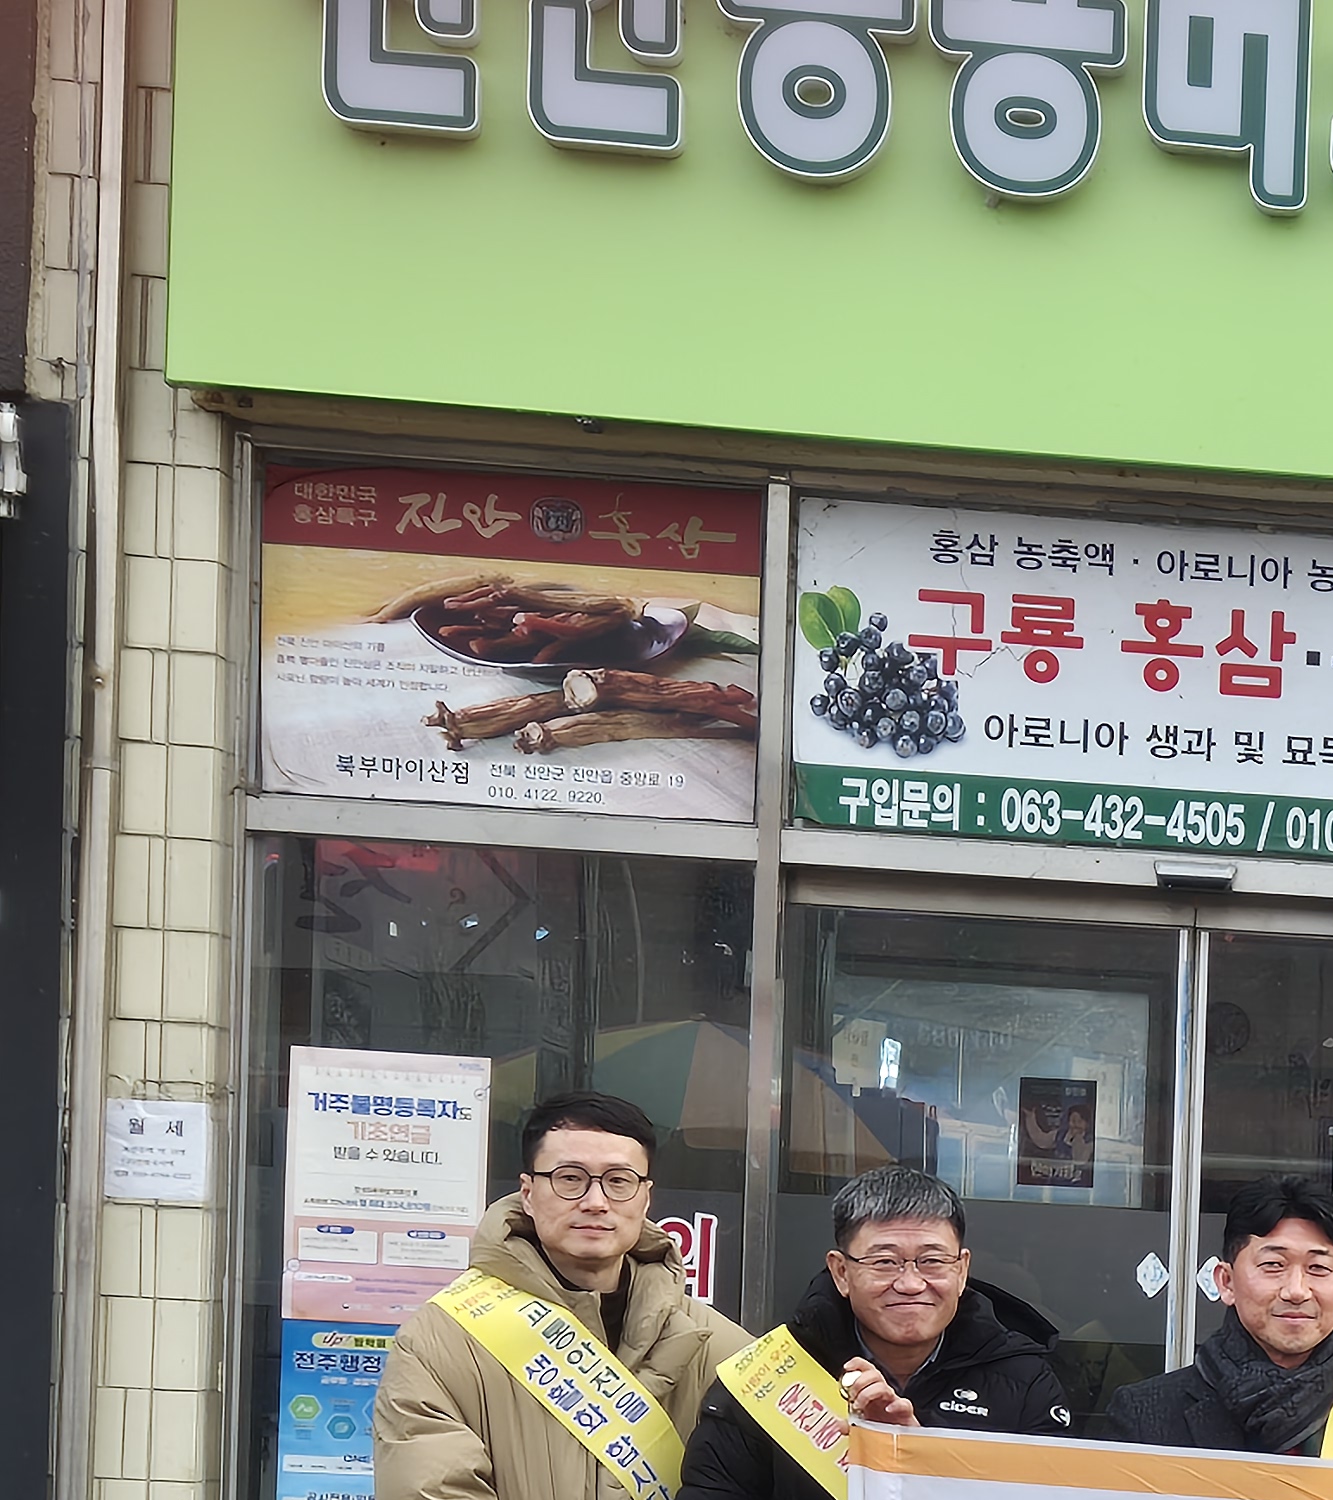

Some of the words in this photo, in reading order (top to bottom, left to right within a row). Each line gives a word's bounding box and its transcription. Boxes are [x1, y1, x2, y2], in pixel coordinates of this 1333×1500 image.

[293, 481, 378, 504] 대한민국
[293, 504, 378, 527] 홍삼특구
[395, 492, 523, 539] 진안
[588, 492, 738, 560] 홍삼
[928, 529, 999, 568] 홍삼
[1012, 536, 1116, 576] 농축액
[1156, 548, 1295, 591] 아로니아
[908, 588, 1085, 685] 구룡
[983, 713, 1130, 757] 아로니아
[1146, 725, 1217, 764] 생과
[1234, 731, 1265, 765] 및
[335, 753, 471, 786] 북부마이산점
[666, 774, 685, 789] 19
[838, 777, 962, 831] 구입문의
[1000, 786, 1247, 846] 063-432-4505
[347, 1121, 432, 1146] 기초연금
[365, 1148, 379, 1161] 수
